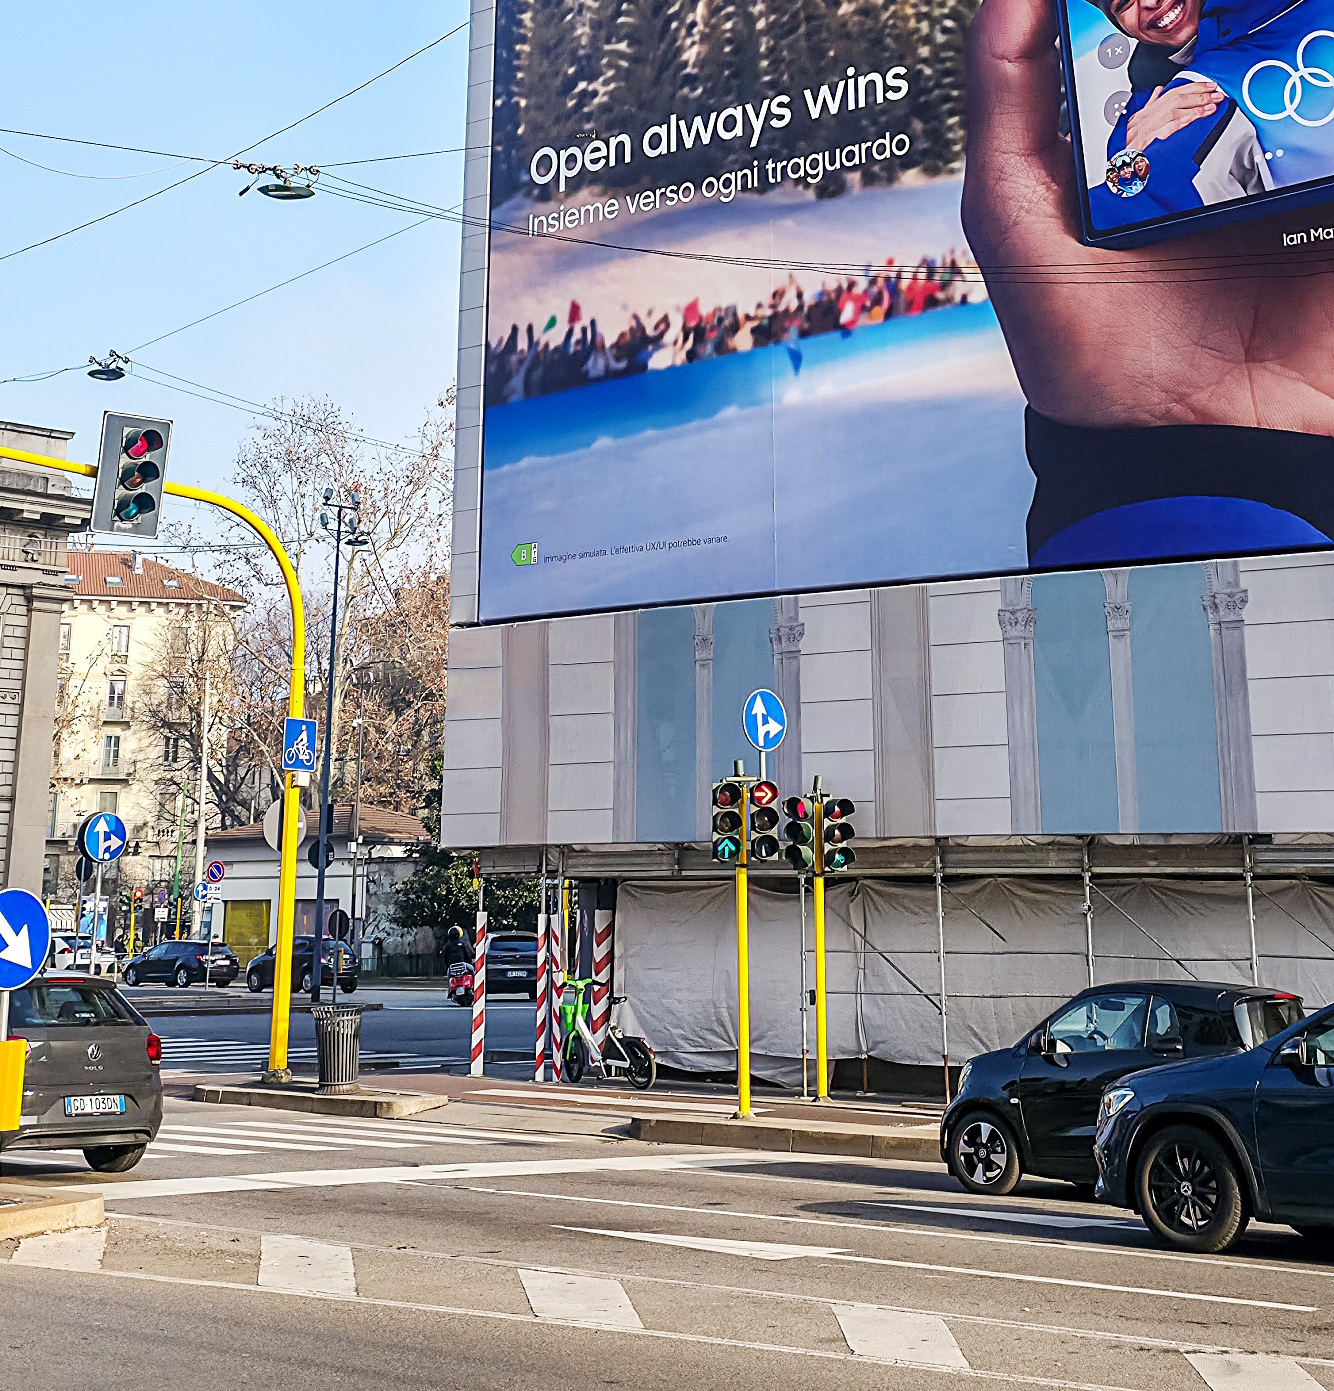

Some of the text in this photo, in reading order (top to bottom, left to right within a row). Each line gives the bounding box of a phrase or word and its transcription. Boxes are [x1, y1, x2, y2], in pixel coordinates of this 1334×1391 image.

[529, 65, 910, 192] Open always wins
[528, 132, 910, 237] Insieme verso ogni traguardo
[1282, 231, 1308, 247] Ian
[543, 552, 577, 564] Immagine
[578, 548, 609, 559] simulata.
[645, 540, 667, 552] UX/UI
[668, 538, 701, 551] potrebbe
